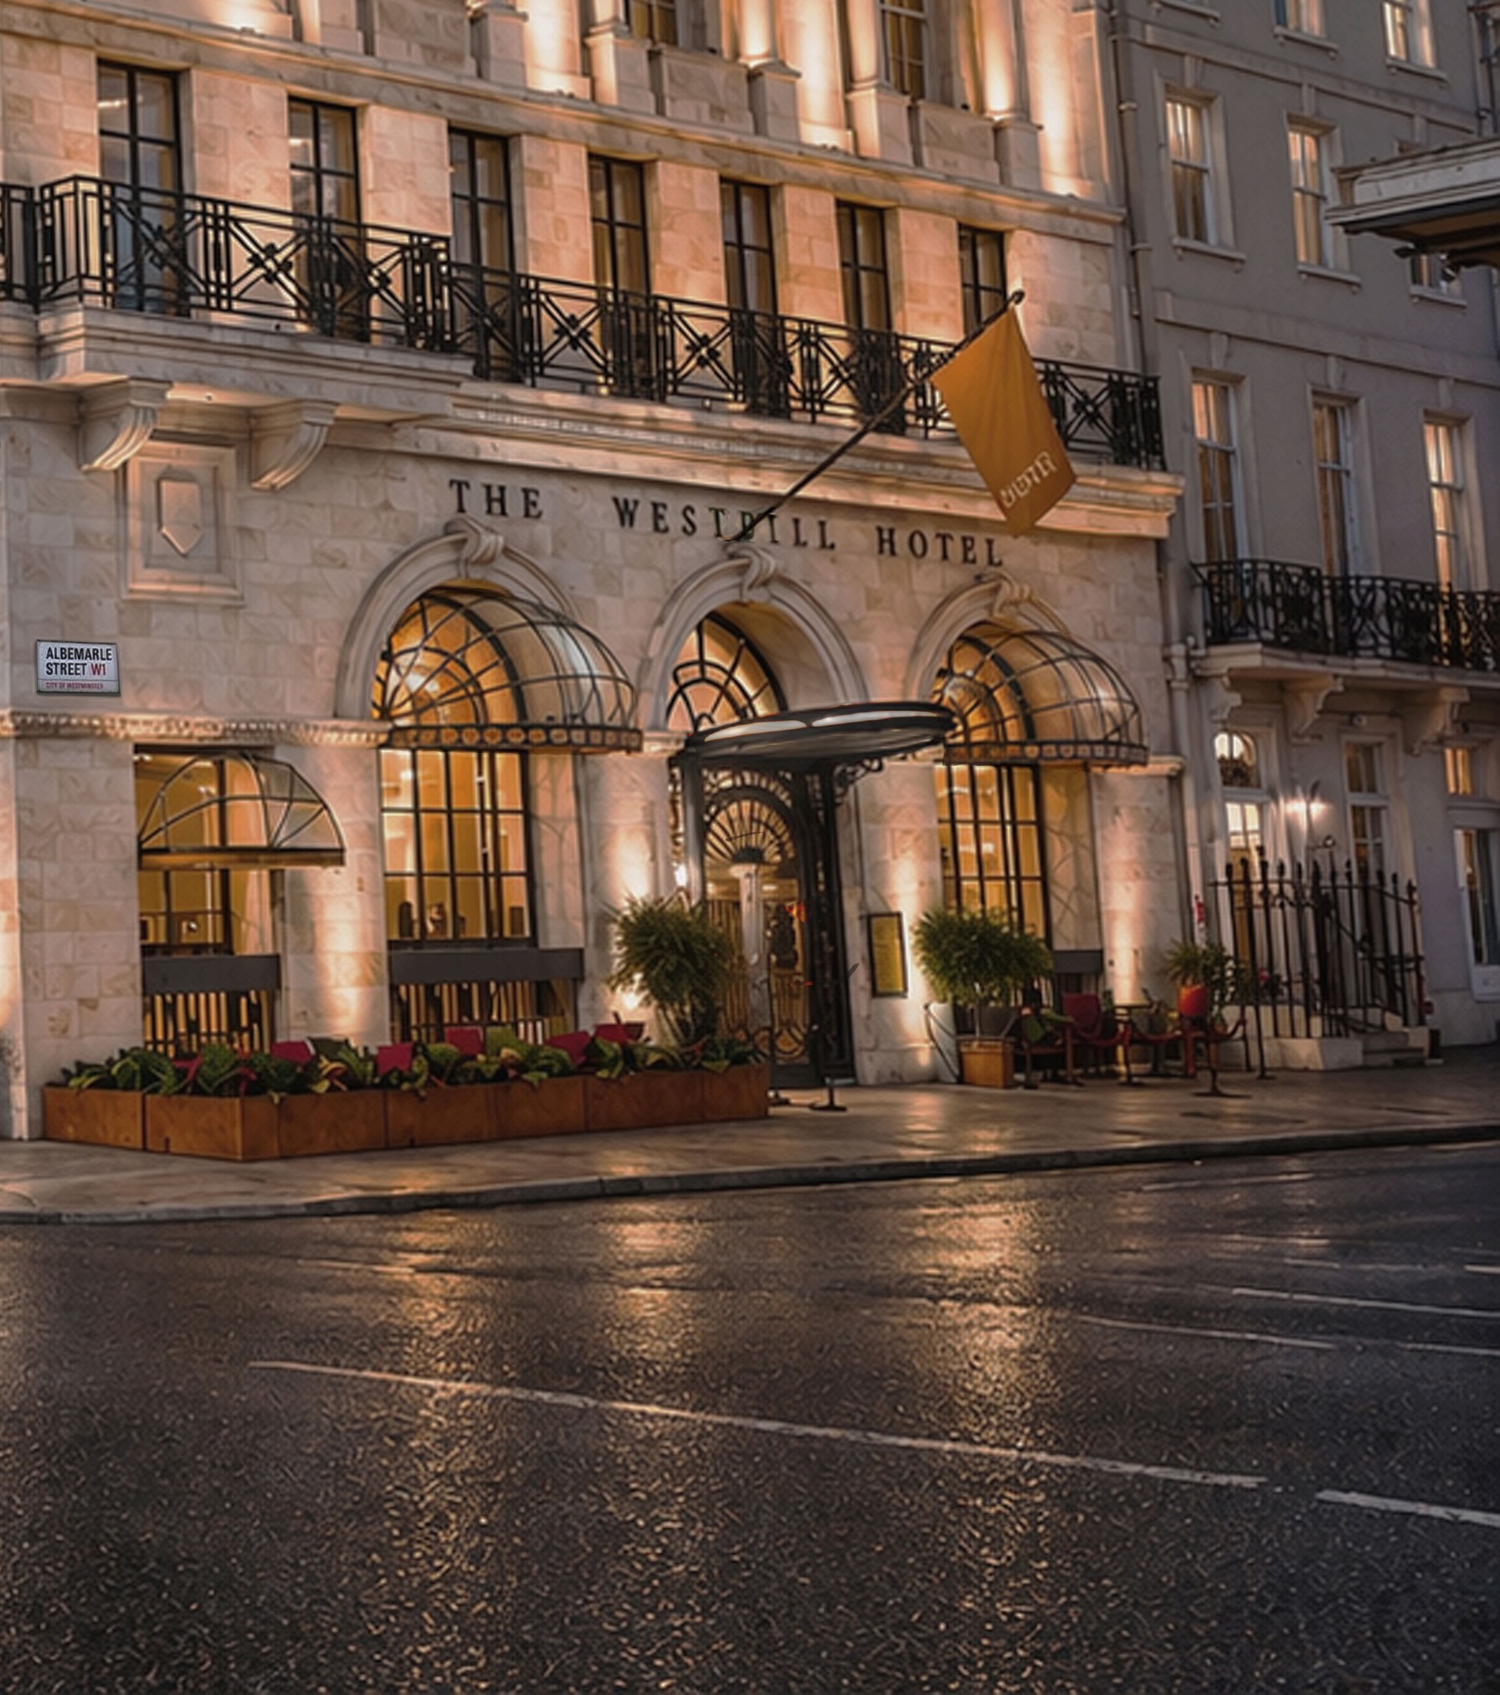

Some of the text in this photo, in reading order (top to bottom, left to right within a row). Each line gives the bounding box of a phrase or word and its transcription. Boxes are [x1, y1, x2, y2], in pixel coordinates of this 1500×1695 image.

[449, 479, 543, 519] THE
[876, 525, 1003, 567] HOTEL
[46, 647, 112, 661] ALBEMARLE
[46, 662, 107, 676] STREET W1
